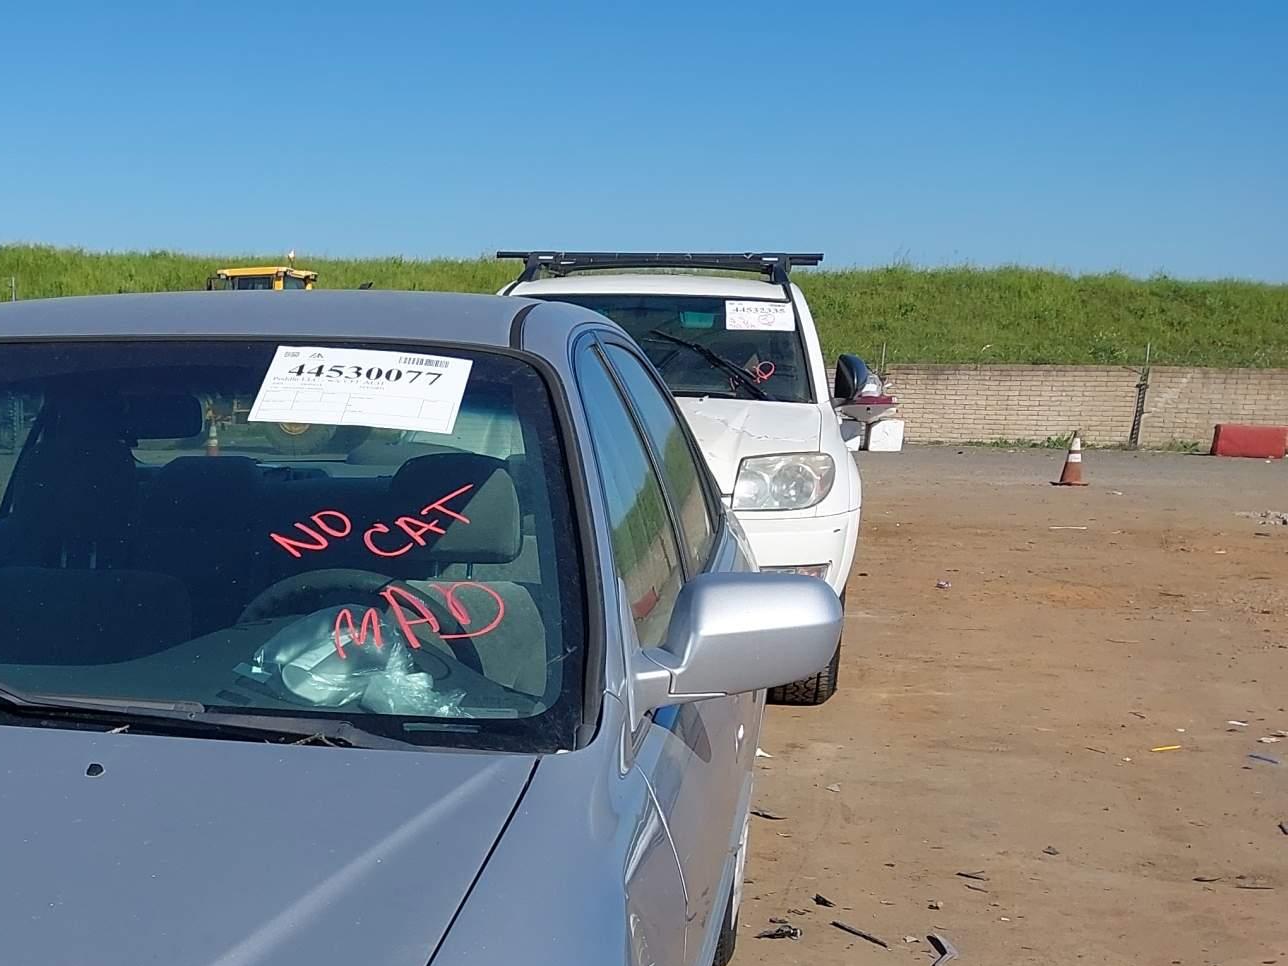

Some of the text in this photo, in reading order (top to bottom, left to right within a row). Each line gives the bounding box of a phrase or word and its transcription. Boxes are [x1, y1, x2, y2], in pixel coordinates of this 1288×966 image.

[287, 363, 444, 387] 44530077
[269, 483, 474, 559] NO CAT
